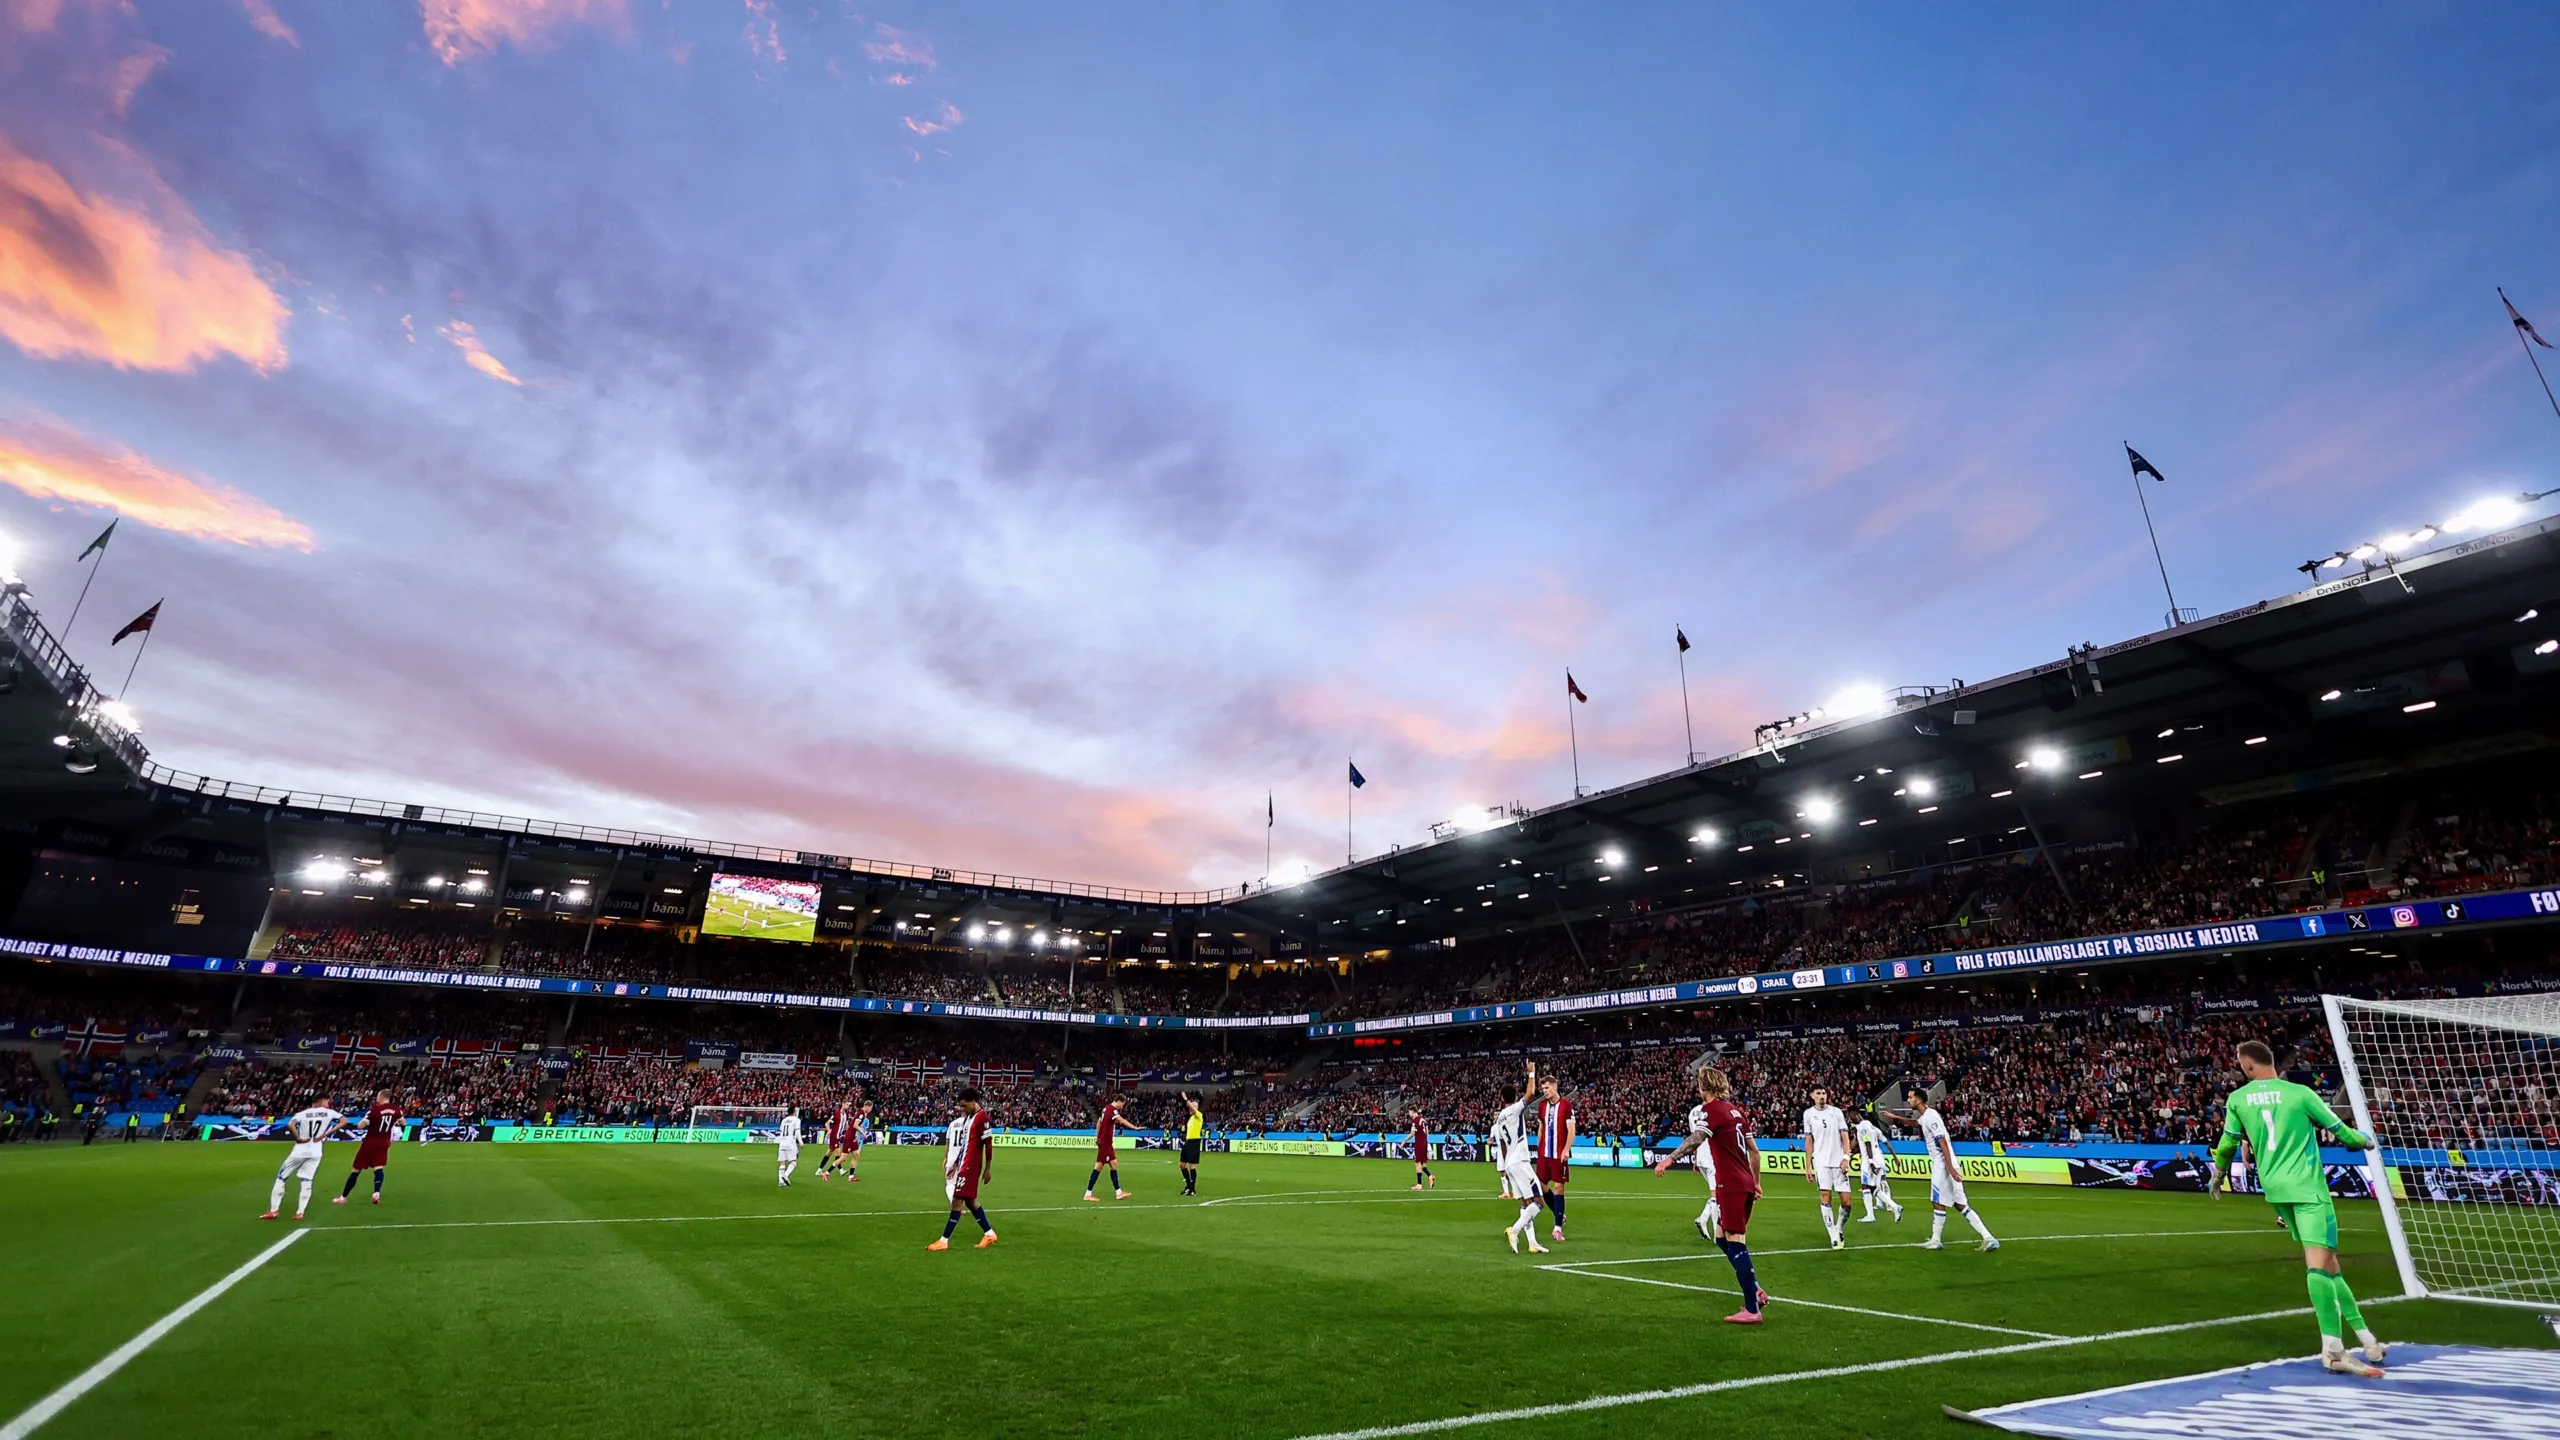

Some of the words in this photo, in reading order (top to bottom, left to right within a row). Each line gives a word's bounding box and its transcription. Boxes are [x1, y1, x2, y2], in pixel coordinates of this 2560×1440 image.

[652, 901, 685, 916] bama
[825, 916, 854, 931] bama
[903, 926, 930, 940] bama
[1141, 943, 1167, 956] bama
[1199, 945, 1225, 957] bama
[1280, 941, 1302, 954] bama
[1955, 953, 1984, 971] FØLG
[1987, 940, 2111, 968] FOTBALLANDSLAGET
[2113, 936, 2134, 954] PÅ
[2135, 932, 2196, 953] SOSIALE
[2198, 924, 2260, 947] MEDIER
[50, 943, 67, 958] PÅ
[70, 947, 121, 963] SOSIALE
[122, 952, 171, 968] MEDIER
[324, 965, 349, 978] FØLG
[351, 967, 449, 985] FOTBALLANDSLAGET
[450, 973, 464, 985] PÅ
[465, 975, 502, 988] SOSIALE
[504, 977, 542, 990] MEDIER
[1762, 977, 1789, 989] ISRAEL
[1797, 974, 1818, 985] 23:31
[1706, 983, 1737, 994] NORWAY
[2501, 981, 2532, 991] Norsk
[667, 987, 689, 999] FØLG
[690, 988, 773, 1004] FOTBALLANDSLAGET
[774, 992, 785, 1004] PÅ
[786, 995, 820, 1007] SOSIALE
[821, 997, 851, 1009] MEDIER
[1534, 1002, 1550, 1015] FØLG
[1550, 994, 1610, 1012] FOTBALLANDSLAGET
[1610, 992, 1621, 1006] PÅ
[1621, 990, 1649, 1004] SOSIALE
[1649, 986, 1678, 1000] MEDIER
[2205, 1001, 2228, 1009] Norsk
[2229, 999, 2259, 1008] Tipping
[2293, 995, 2319, 1004] Norsk
[945, 1005, 963, 1016] FØLG
[964, 1006, 1031, 1020] FOTBALLANDSLAGET
[1042, 1010, 1069, 1022] SOSIALE
[1070, 1013, 1096, 1024] MEDIER
[2001, 1014, 2024, 1023] Tipping
[1880, 1023, 1899, 1031] Tipping
[1937, 1019, 1959, 1027] Tipping
[142, 1031, 168, 1043] Bendit
[304, 1036, 328, 1047] Bendit
[395, 1040, 417, 1051] Bendit
[701, 1046, 728, 1056] bama
[204, 1046, 245, 1060] bama
[2246, 1091, 2282, 1107] PERETZ
[379, 1115, 393, 1133] 14
[1822, 1119, 1827, 1129] 5
[2261, 1110, 2277, 1151] 1
[533, 1128, 615, 1144] BREITLING
[783, 1125, 789, 1137] 11
[1244, 1142, 1279, 1152] BREITLING
